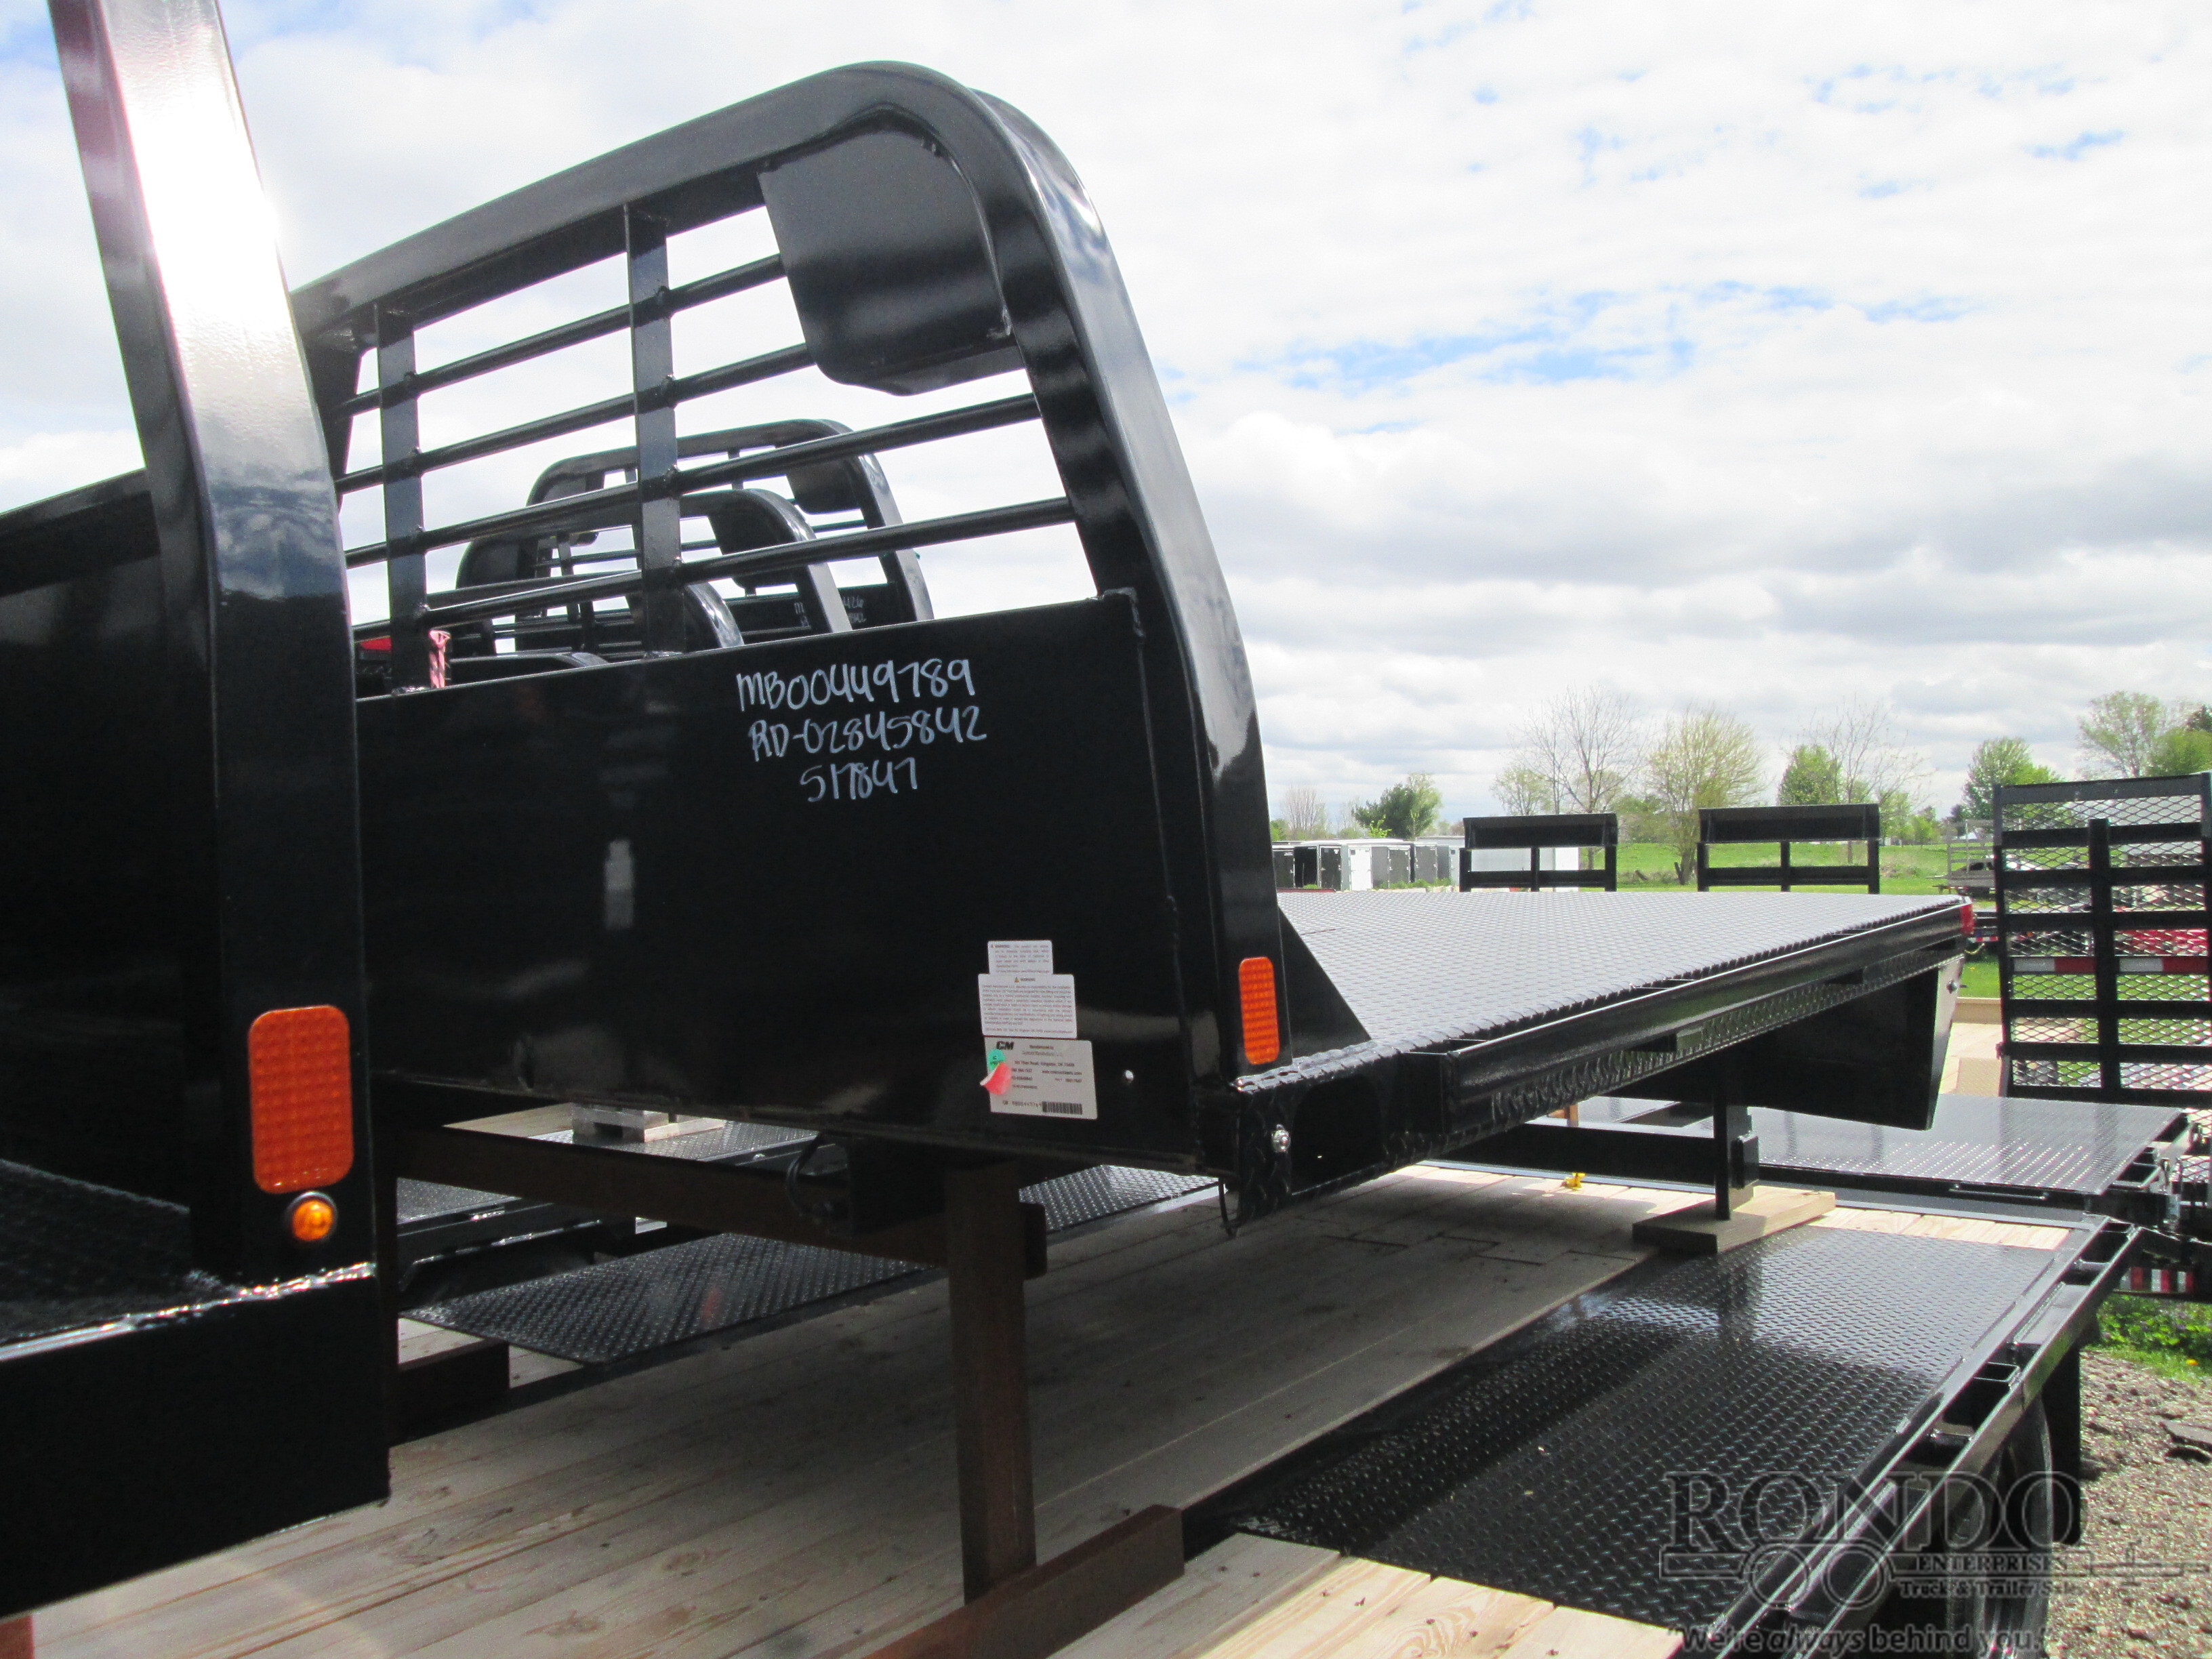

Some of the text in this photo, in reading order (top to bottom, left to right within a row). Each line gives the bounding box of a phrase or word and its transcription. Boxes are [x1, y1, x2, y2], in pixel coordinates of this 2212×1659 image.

[736, 658, 976, 712] MB00449789
[748, 705, 987, 762] RD-02845842
[799, 757, 918, 802] 517847
